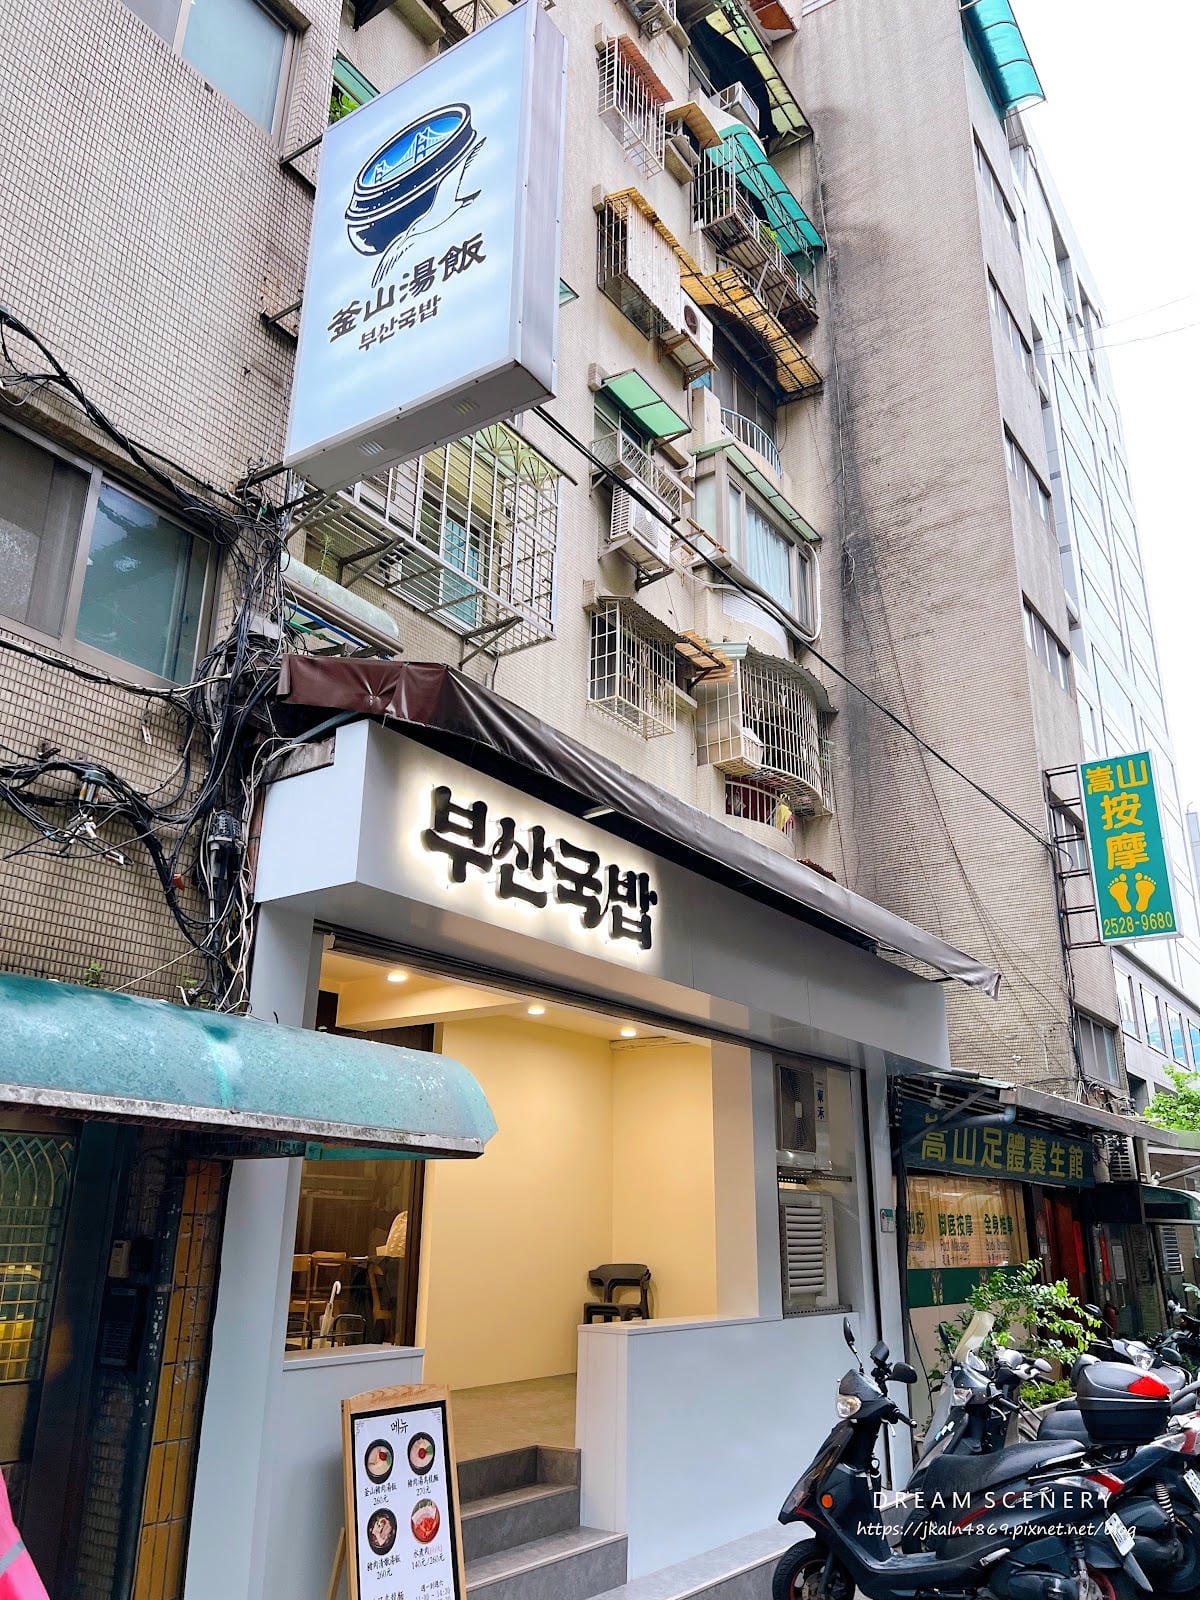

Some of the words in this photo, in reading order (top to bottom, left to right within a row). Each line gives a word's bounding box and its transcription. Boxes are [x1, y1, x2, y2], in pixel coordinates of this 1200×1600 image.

[327, 232, 486, 343] 釜山湯飯
[358, 294, 441, 351] 부산국밥
[1086, 759, 1149, 795] 嵩山
[1101, 792, 1150, 870] 按摩
[420, 785, 658, 950] 부산국밥
[1103, 911, 1173, 936] 2528-9680
[390, 1418, 409, 1434] 메뉴
